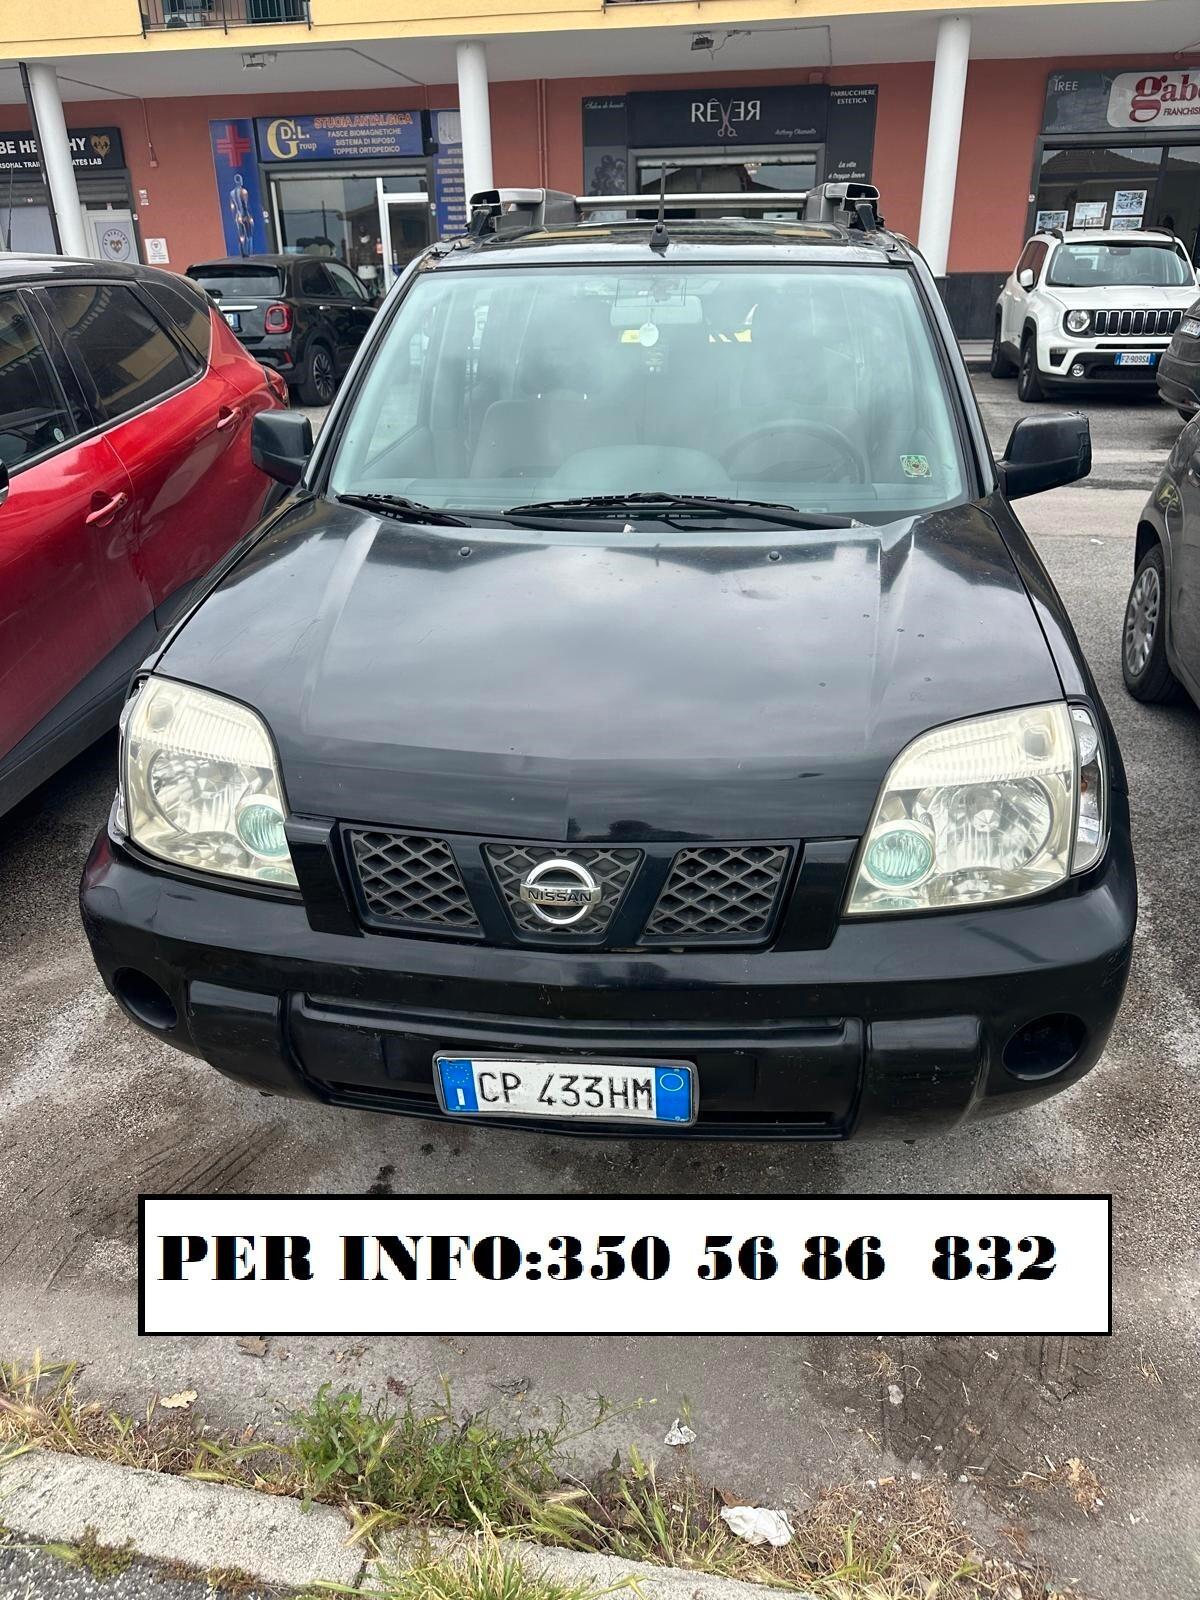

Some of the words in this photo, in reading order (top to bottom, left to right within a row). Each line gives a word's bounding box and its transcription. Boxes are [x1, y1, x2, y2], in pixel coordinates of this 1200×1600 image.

[830, 89, 876, 97] PARRUCCHIERE
[1129, 74, 1200, 122] gab
[837, 97, 868, 105] ESTETICA
[1162, 106, 1200, 117] FRANCHIS
[353, 113, 413, 127] ANTALGICA
[327, 130, 349, 138] FASCE
[350, 128, 402, 137] BIOMAGNETICHE
[336, 138, 363, 146] SISTEMA
[0, 141, 17, 155] BE
[332, 147, 359, 155] TOPPER
[359, 145, 401, 154] ORTOPEDICO
[89, 157, 103, 165] LAB
[527, 889, 592, 902] NISSAN
[477, 1071, 522, 1103] CP
[537, 1072, 654, 1111] 433HM
